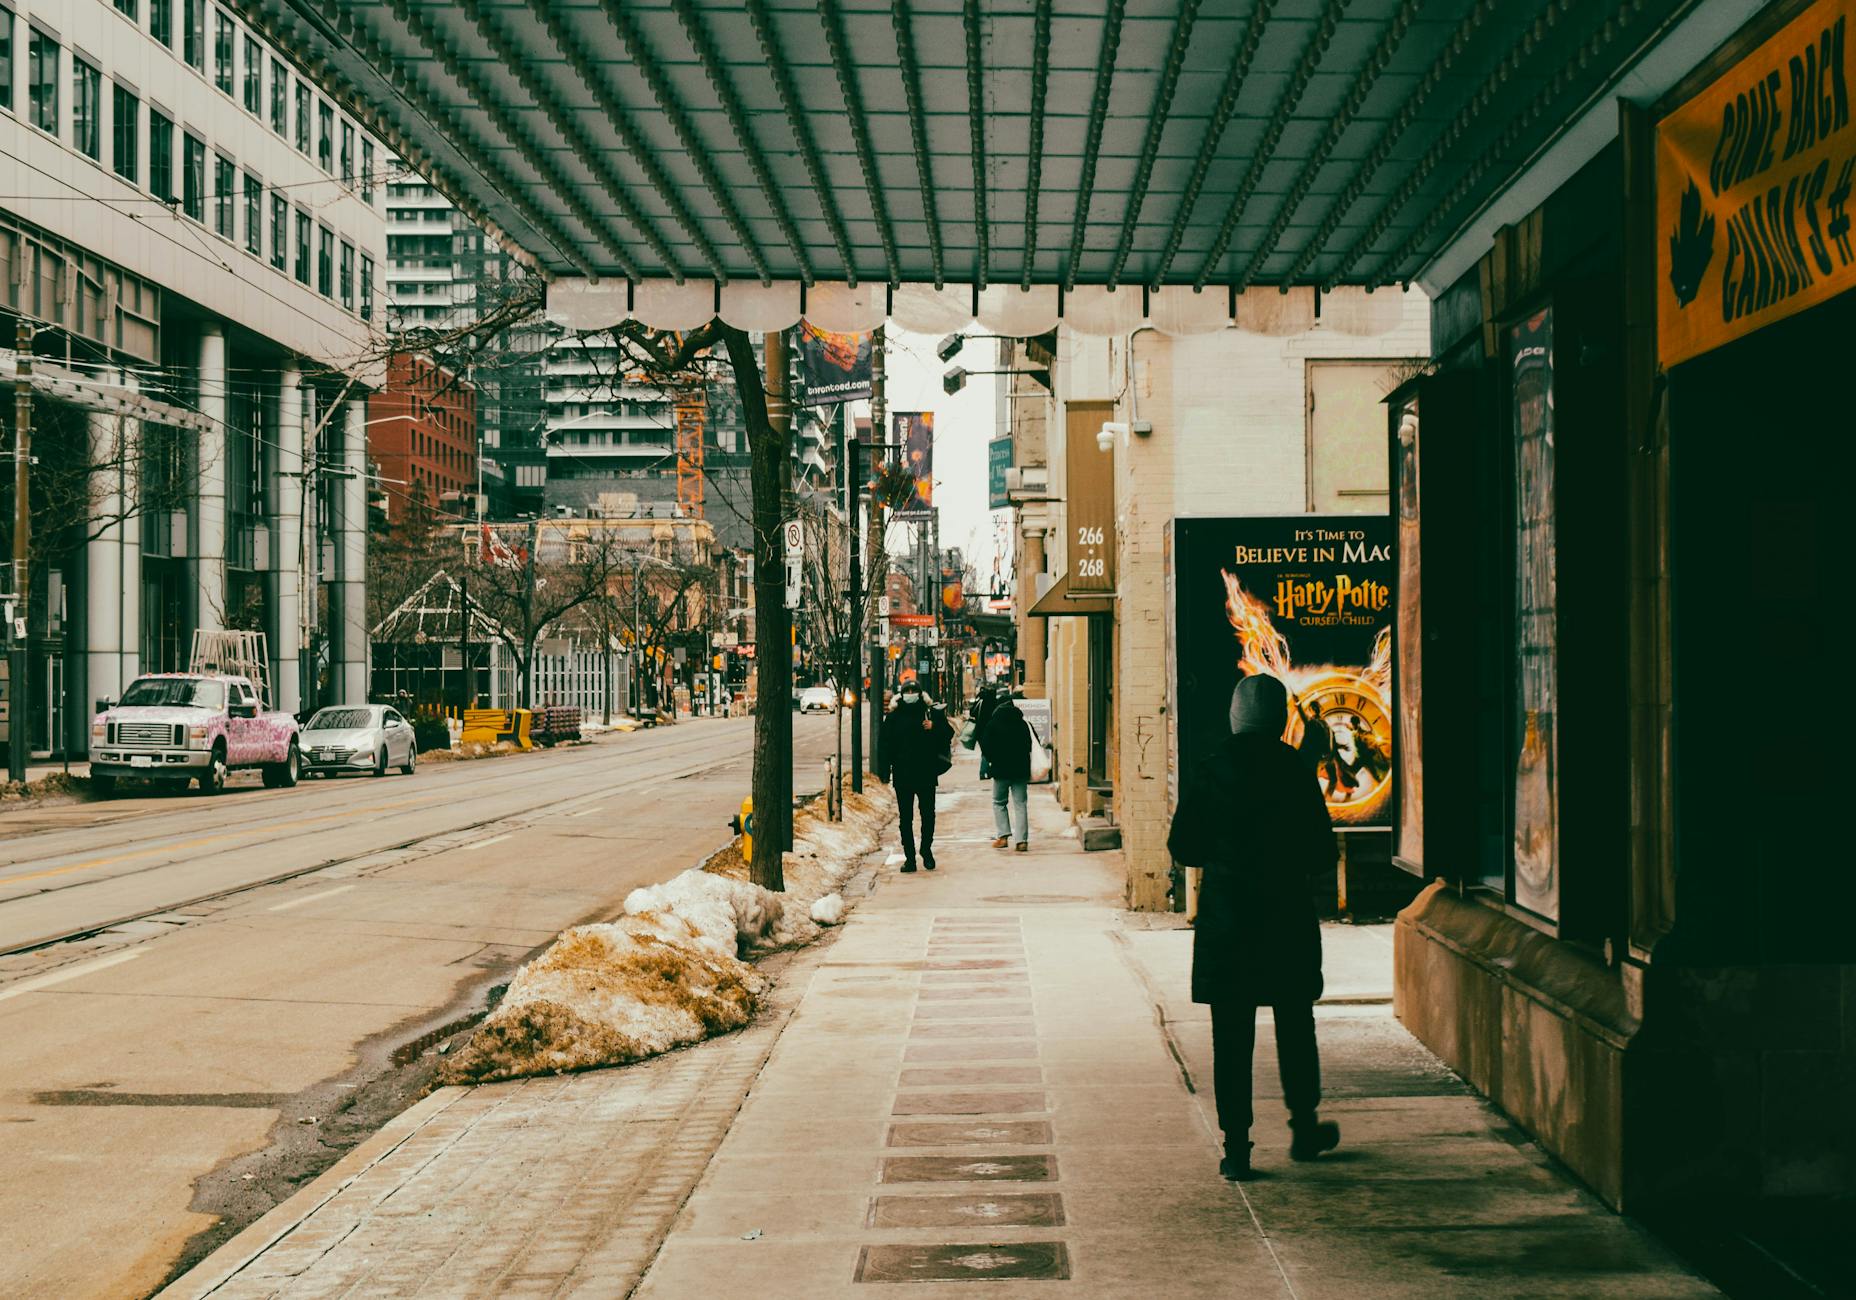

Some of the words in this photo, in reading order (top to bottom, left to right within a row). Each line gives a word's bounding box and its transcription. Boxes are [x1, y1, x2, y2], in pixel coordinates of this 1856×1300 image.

[1710, 69, 1782, 198] COME
[1782, 15, 1849, 162] BACK
[1078, 527, 1104, 545] 266
[1235, 545, 1307, 564] BELIEVE
[1313, 548, 1334, 562] IN
[1078, 559, 1104, 577] 268
[1273, 580, 1334, 619] Harry
[1335, 575, 1391, 620] Potte
[1300, 616, 1339, 626] CURSED
[1342, 616, 1375, 625] CHILD
